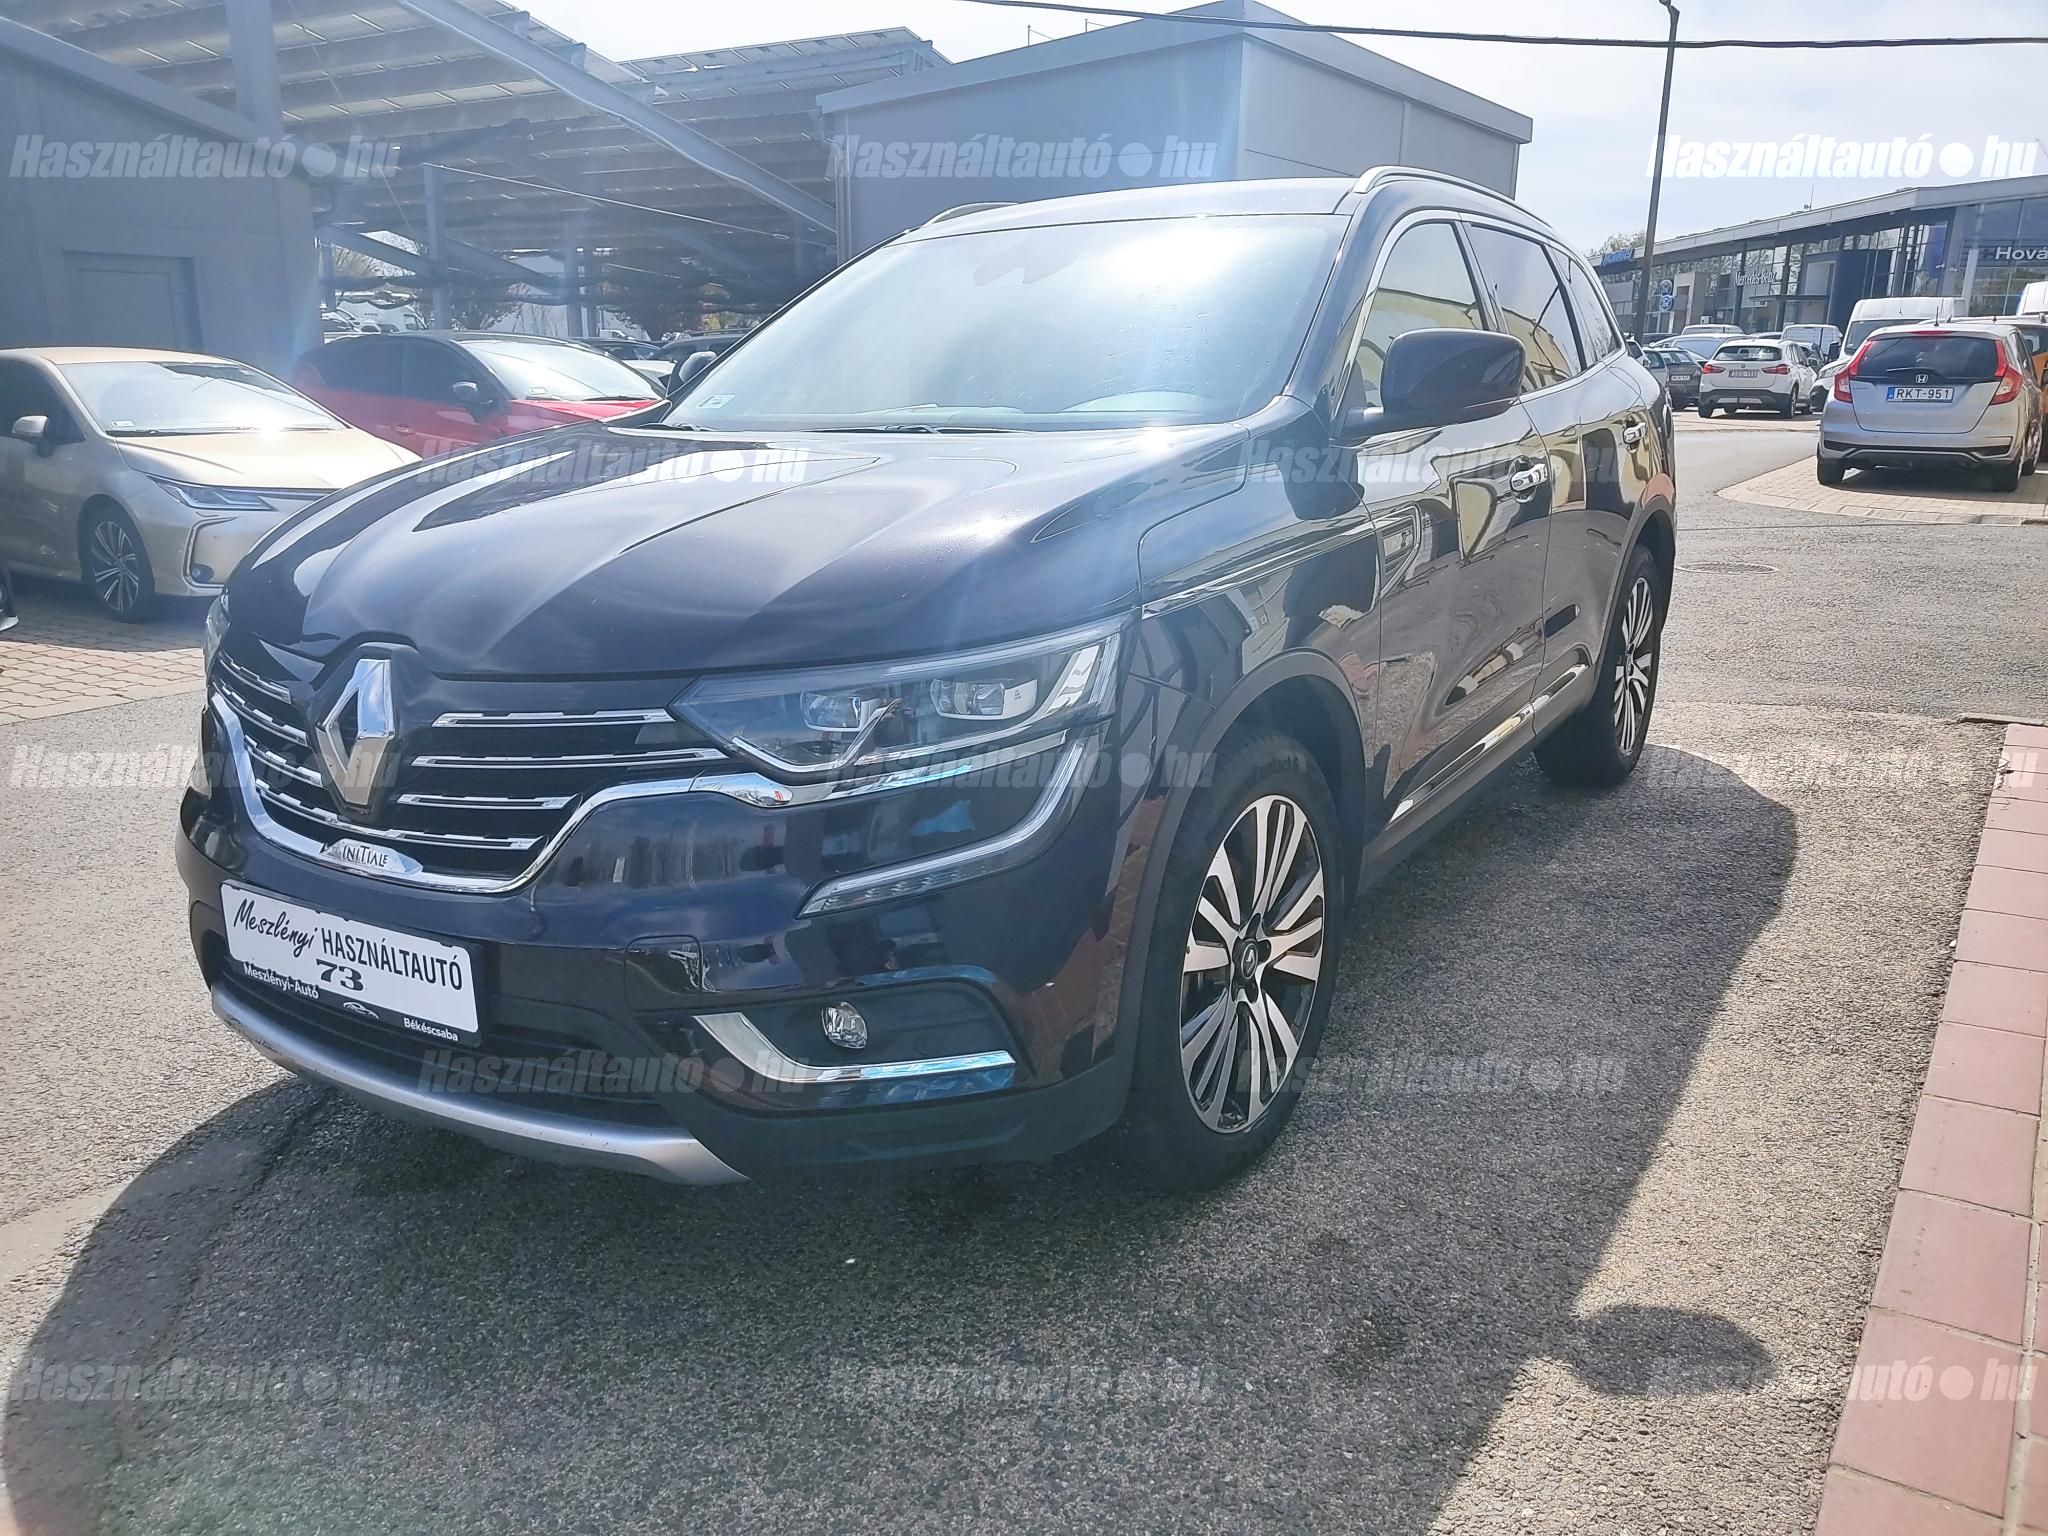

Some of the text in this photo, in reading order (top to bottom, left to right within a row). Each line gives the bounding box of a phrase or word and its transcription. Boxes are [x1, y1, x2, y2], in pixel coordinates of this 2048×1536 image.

[1896, 387, 1949, 399] RKT-951
[342, 845, 389, 868] INITIALE
[233, 899, 463, 991] Meszlényi HASZNÁLTAUTÓ
[316, 958, 364, 992] 73
[244, 962, 459, 1042] Meszlényi-Autó Békéscsaba
